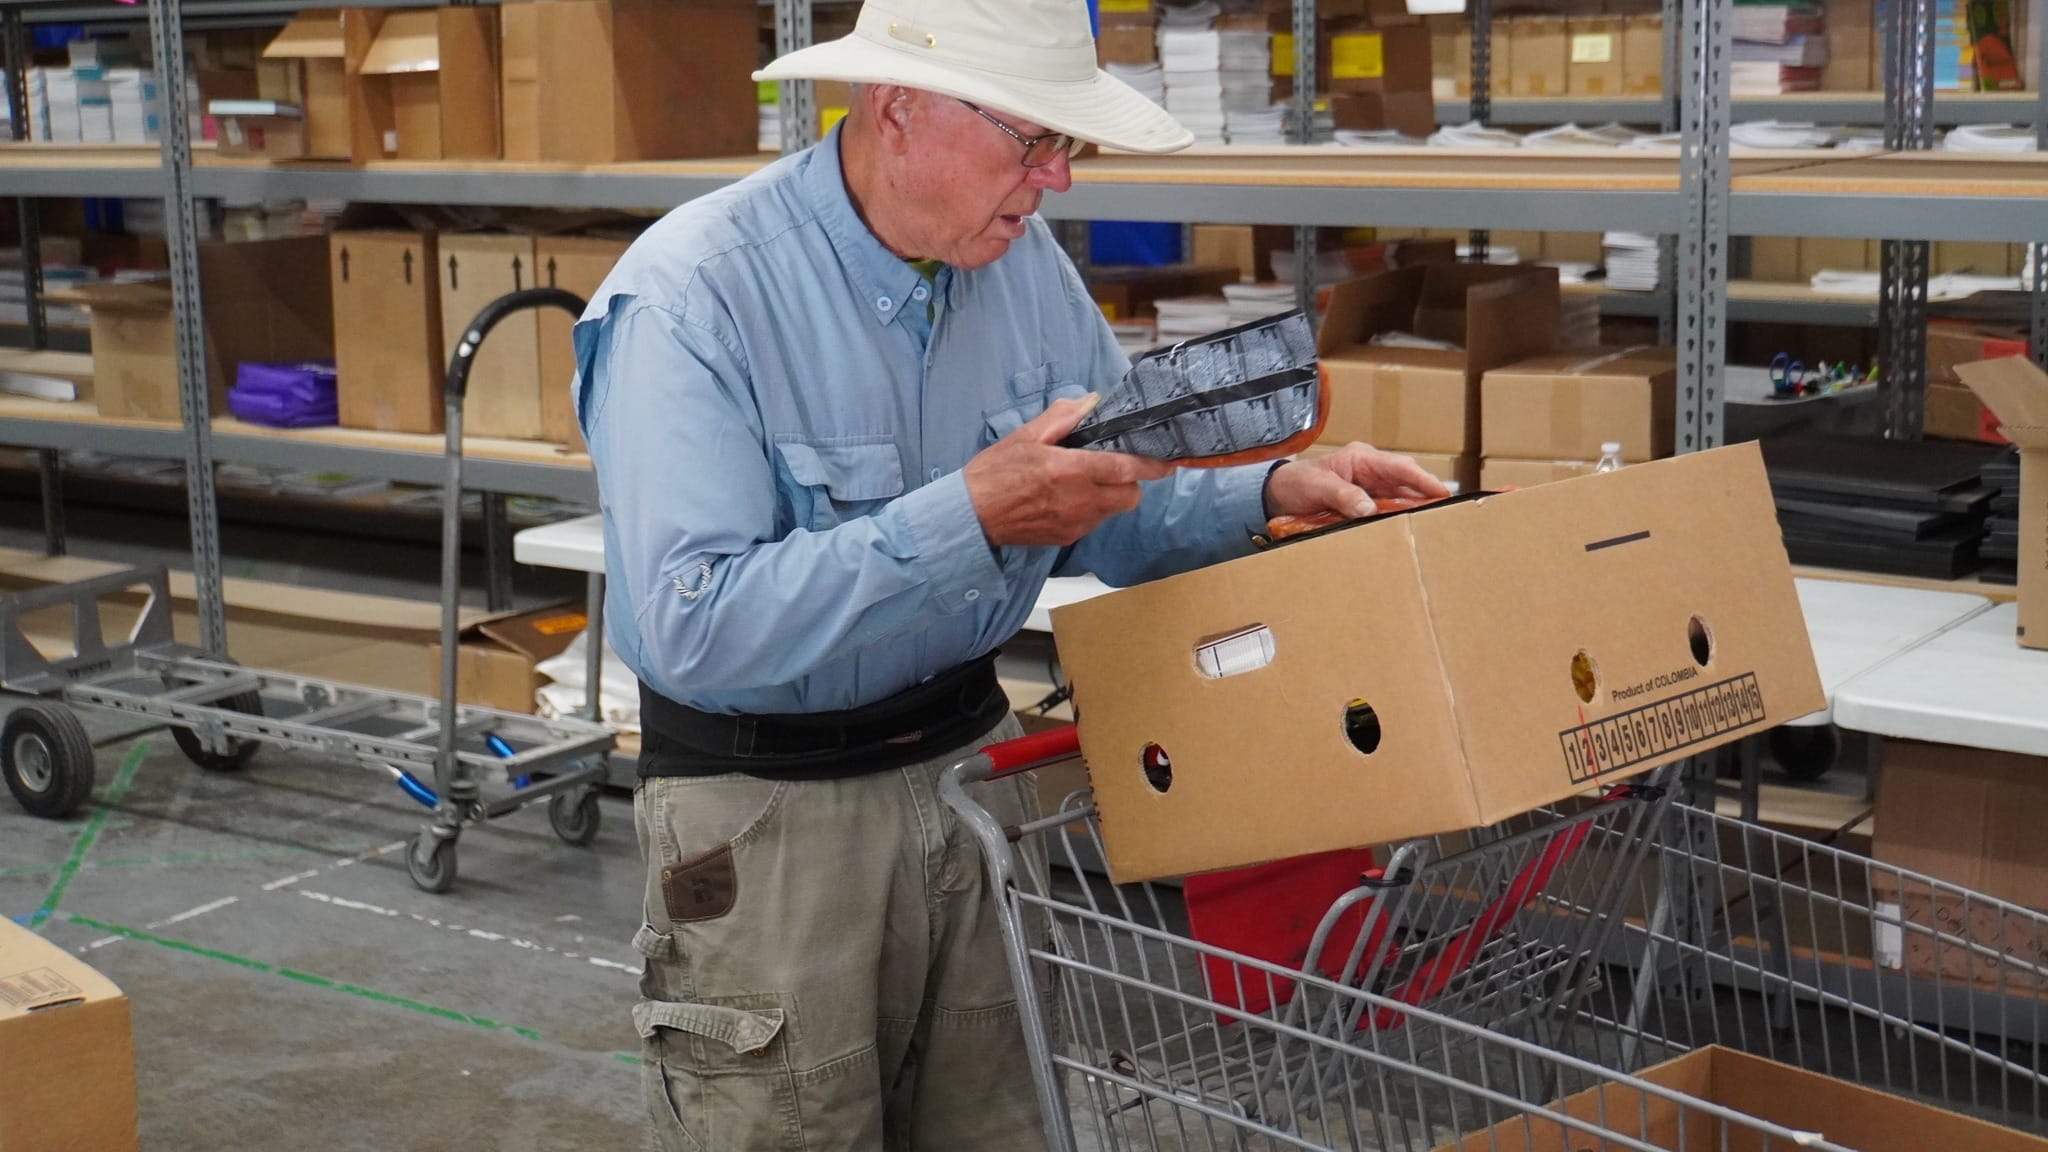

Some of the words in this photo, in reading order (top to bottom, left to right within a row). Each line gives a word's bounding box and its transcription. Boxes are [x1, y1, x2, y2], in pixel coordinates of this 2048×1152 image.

[1611, 682, 1645, 702] Product
[1645, 679, 1654, 692] of
[1654, 666, 1698, 689] COLOMBIA
[1568, 742, 1579, 770] 1
[1582, 738, 1594, 766] 2
[1595, 733, 1607, 762] 3
[1610, 729, 1621, 756] 4
[1622, 724, 1633, 753] 5
[1635, 720, 1646, 748] 6
[1648, 716, 1658, 744] 7
[1661, 712, 1672, 740] 8
[1674, 708, 1685, 735] 9
[1686, 703, 1699, 731] 10
[1699, 698, 1712, 726] 11
[1710, 695, 1725, 723] 12
[1723, 691, 1737, 719] 13
[1735, 687, 1749, 715] 14
[1747, 683, 1760, 710] 15
